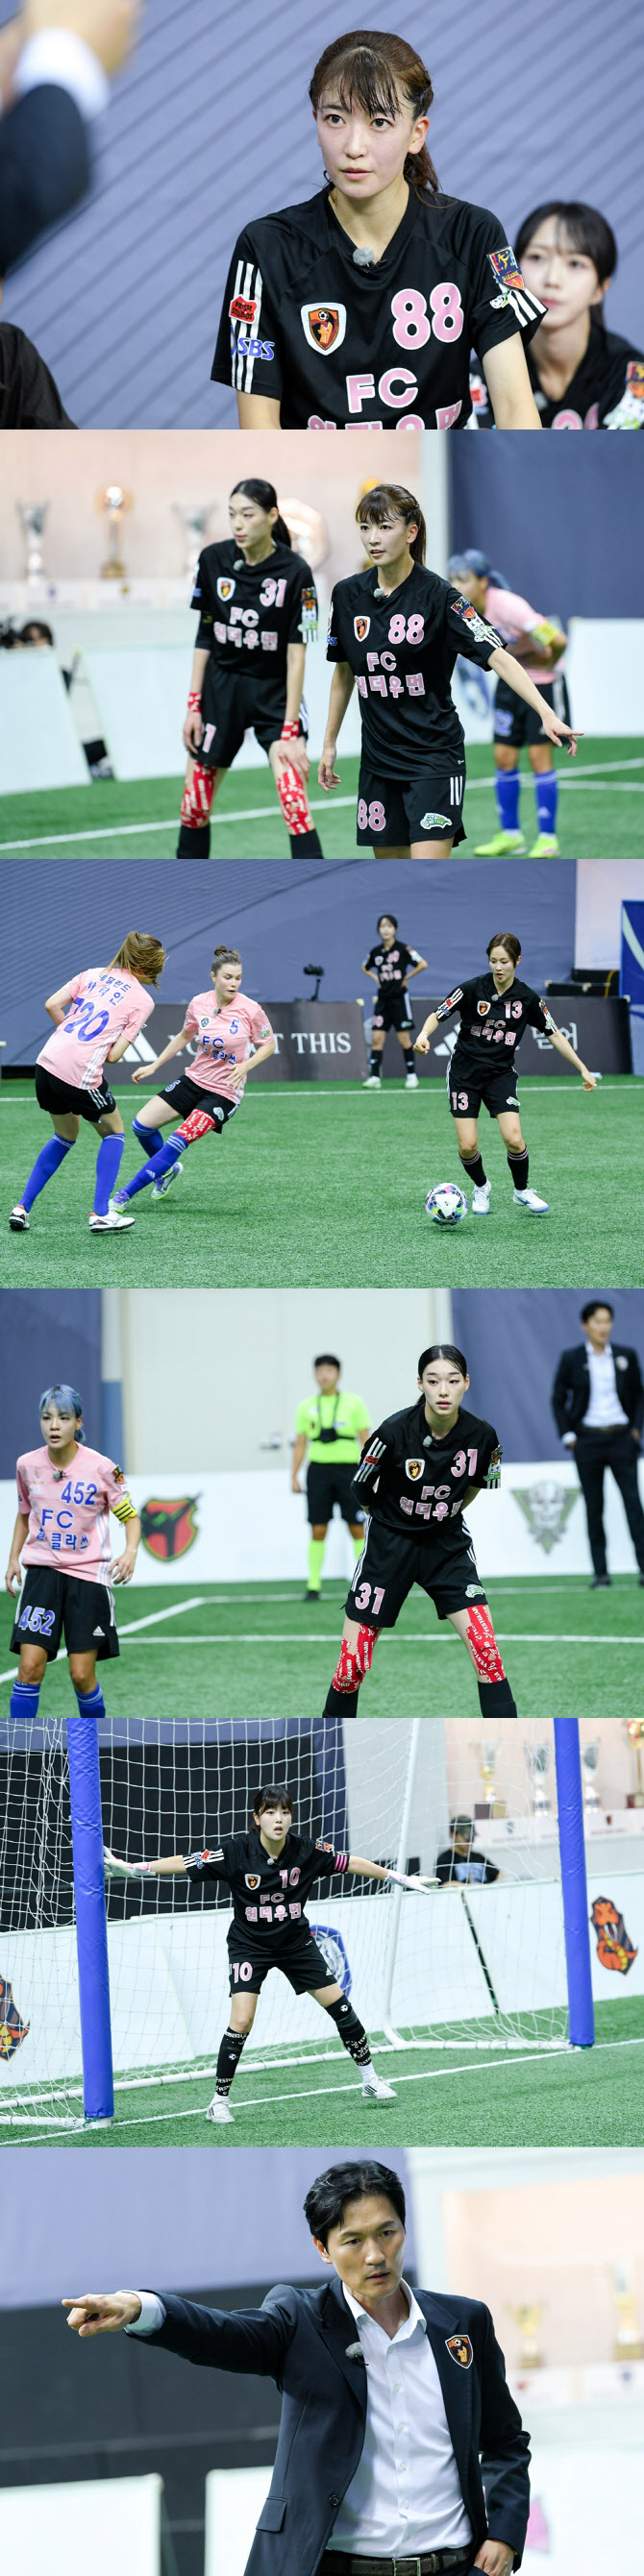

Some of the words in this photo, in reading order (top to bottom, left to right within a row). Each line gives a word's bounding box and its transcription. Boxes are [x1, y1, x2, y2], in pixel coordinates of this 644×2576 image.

[390, 282, 464, 351] 88
[237, 336, 275, 361] SBS
[346, 367, 419, 414] FC
[259, 577, 287, 607] 31
[229, 606, 260, 628] FC
[213, 621, 279, 651] 원더우먼
[327, 634, 338, 646] BS
[387, 613, 425, 645] 88
[366, 650, 397, 673] FC
[200, 723, 217, 754] 1
[357, 797, 386, 832] 88
[504, 1000, 523, 1019] 13
[229, 1018, 240, 1036] 5
[484, 1018, 507, 1030] FC
[202, 1035, 225, 1050] FC
[290, 1032, 352, 1054] THIS
[451, 1092, 469, 1111] 13
[450, 1448, 479, 1478] 31
[61, 1480, 98, 1507] 452
[420, 1484, 452, 1501] FC
[41, 1509, 74, 1530] FC
[355, 1582, 386, 1615] 31
[18, 1605, 56, 1636] 452
[279, 1866, 301, 1889] 10
[260, 1892, 285, 1905] FC
[244, 1902, 302, 1923] 원더우먼
[232, 1961, 253, 1984] 10
